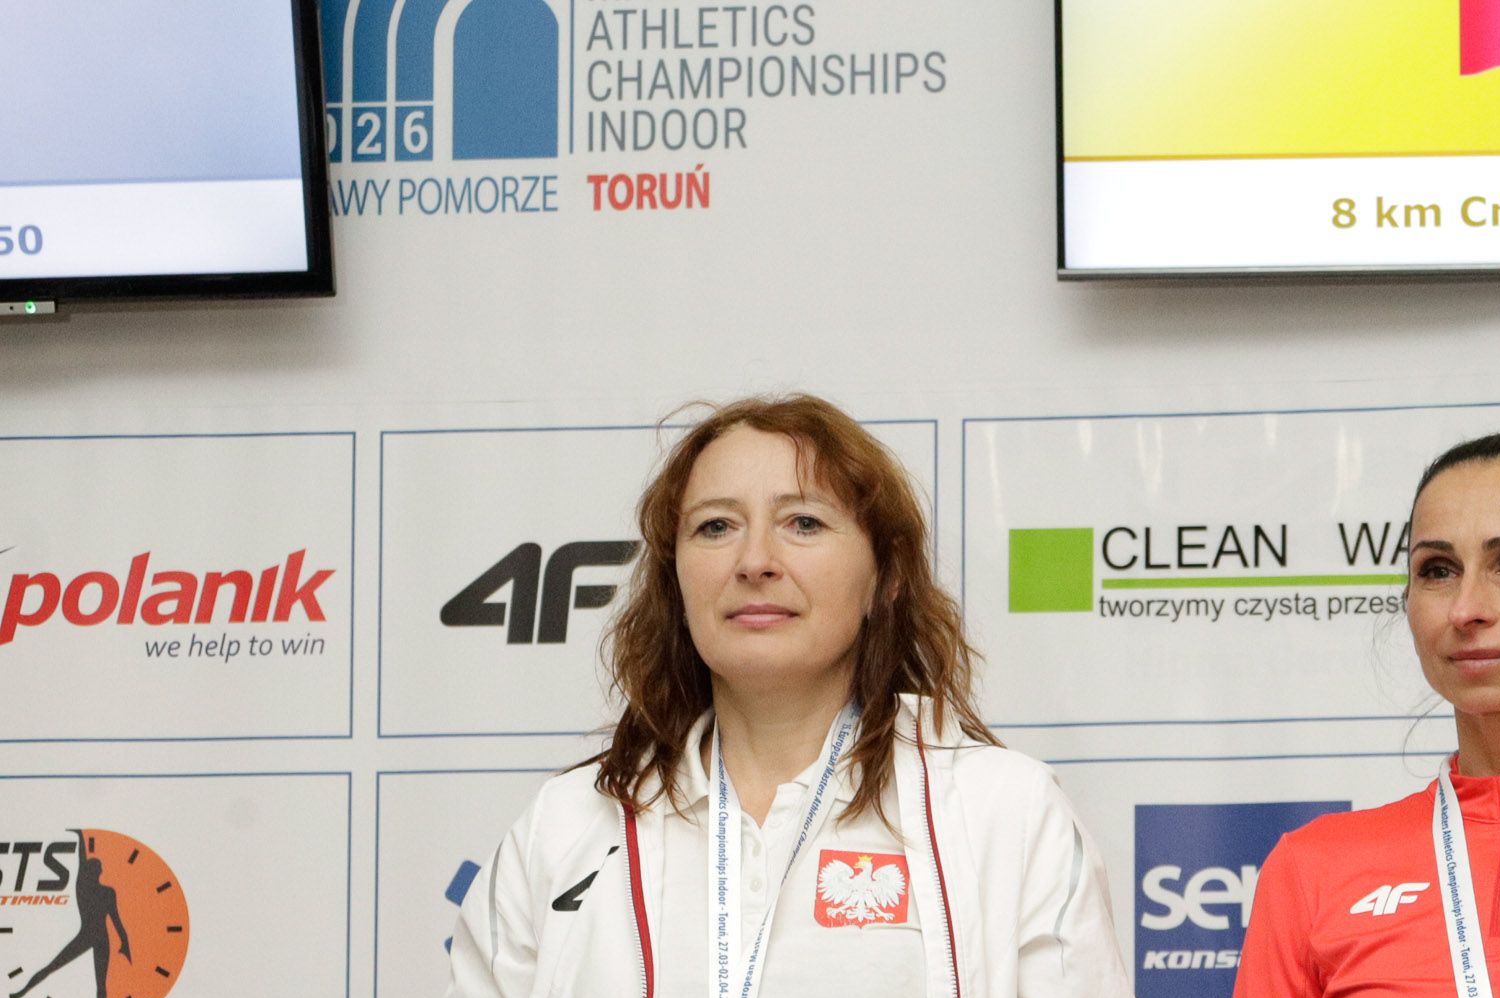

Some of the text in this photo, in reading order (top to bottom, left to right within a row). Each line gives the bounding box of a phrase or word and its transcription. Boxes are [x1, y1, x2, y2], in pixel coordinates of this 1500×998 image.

[587, 4, 814, 51] ATHLETICS
[587, 52, 946, 102] CHAMPIONSHIPS
[588, 108, 746, 152] INDOOR
[399, 176, 557, 215] POMORZE
[587, 164, 709, 210] TORUŃ
[1332, 198, 1356, 228] 8
[1377, 197, 1441, 227] km
[1102, 525, 1286, 570] CLEAN
[0, 549, 335, 646] polanik
[440, 541, 641, 644] 4F
[1099, 597, 1224, 622] tworzymy
[1235, 593, 1319, 621] czystą
[146, 633, 324, 663] we help to win
[718, 881, 728, 905] Indoor
[1349, 882, 1430, 917] 4F
[1446, 859, 1464, 917] Championships
[1455, 916, 1466, 945] Indoor
